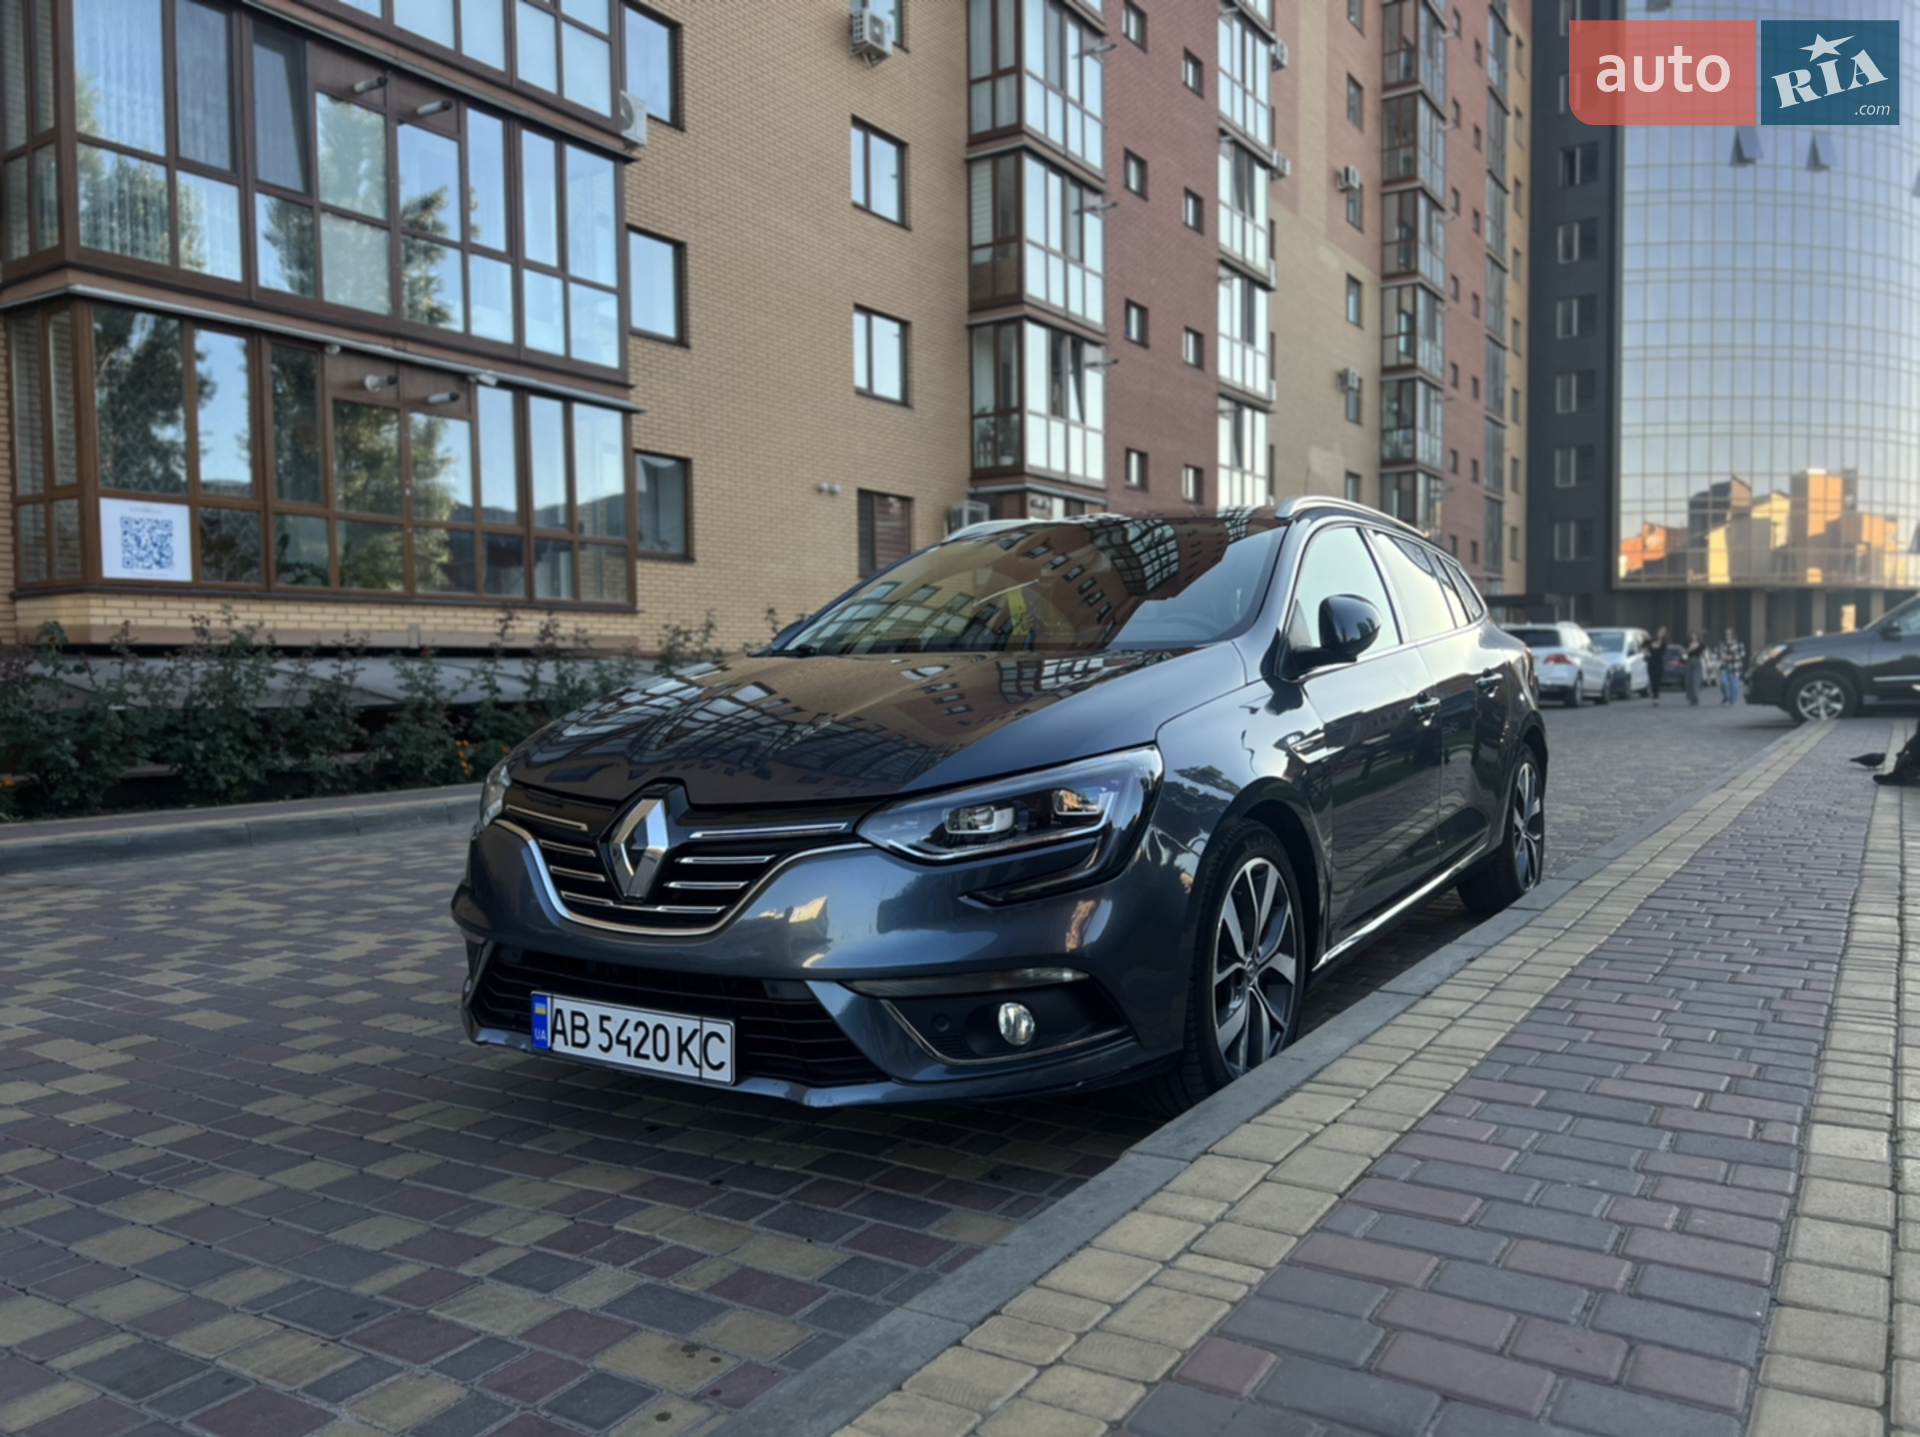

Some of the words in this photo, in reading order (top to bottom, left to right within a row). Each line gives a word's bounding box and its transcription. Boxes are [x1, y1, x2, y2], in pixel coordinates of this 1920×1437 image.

[534, 1027, 547, 1041] UA
[552, 1008, 591, 1049] AB
[598, 1014, 670, 1062] 5420
[677, 1026, 727, 1071] KC
